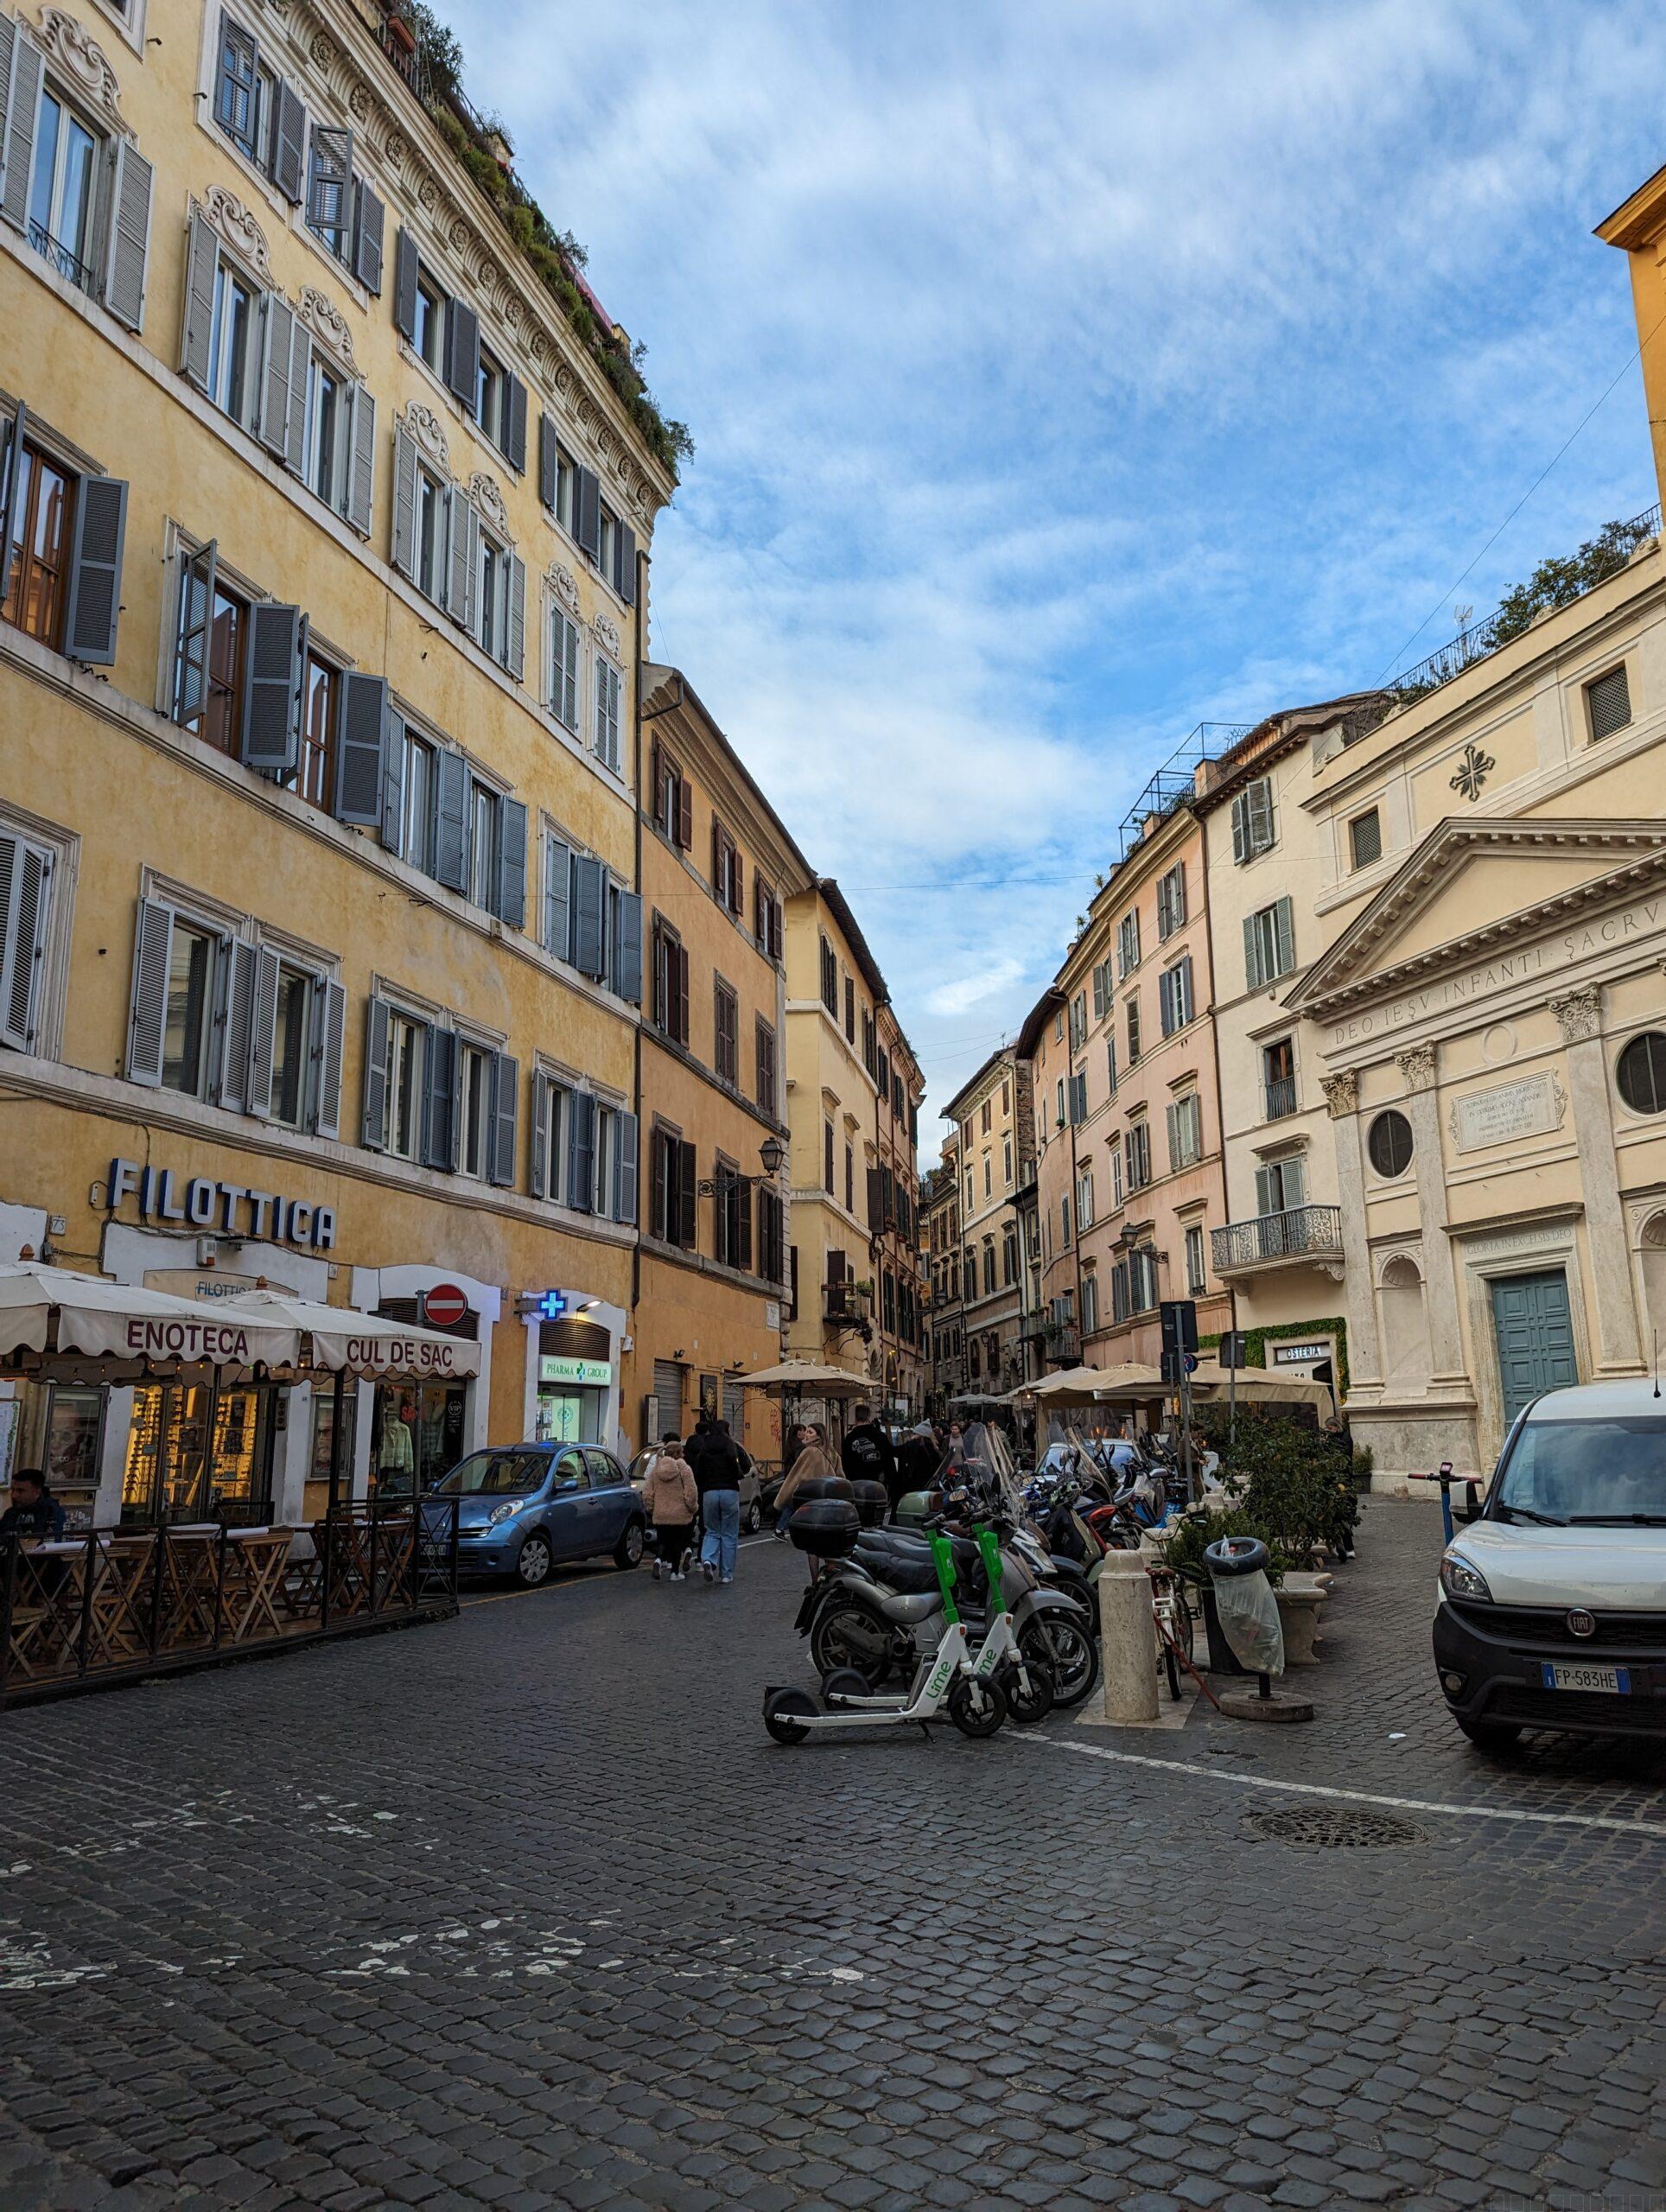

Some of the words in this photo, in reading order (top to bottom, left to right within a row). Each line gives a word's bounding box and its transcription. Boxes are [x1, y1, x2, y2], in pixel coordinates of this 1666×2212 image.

[1335, 1016, 1372, 1045] DEO
[1444, 949, 1542, 1003] INFANTI
[108, 1158, 336, 1249] FILOTTICA
[52, 1218, 65, 1231] 73
[127, 1320, 249, 1357] ENOTECA
[347, 1339, 385, 1363] CUL
[390, 1341, 415, 1363] DE
[420, 1344, 453, 1367] SAC
[1287, 1347, 1319, 1358] OSTERIA
[546, 1363, 574, 1376] PHARMA
[587, 1368, 607, 1378] GROUP
[1573, 1617, 1588, 1630] FIAT
